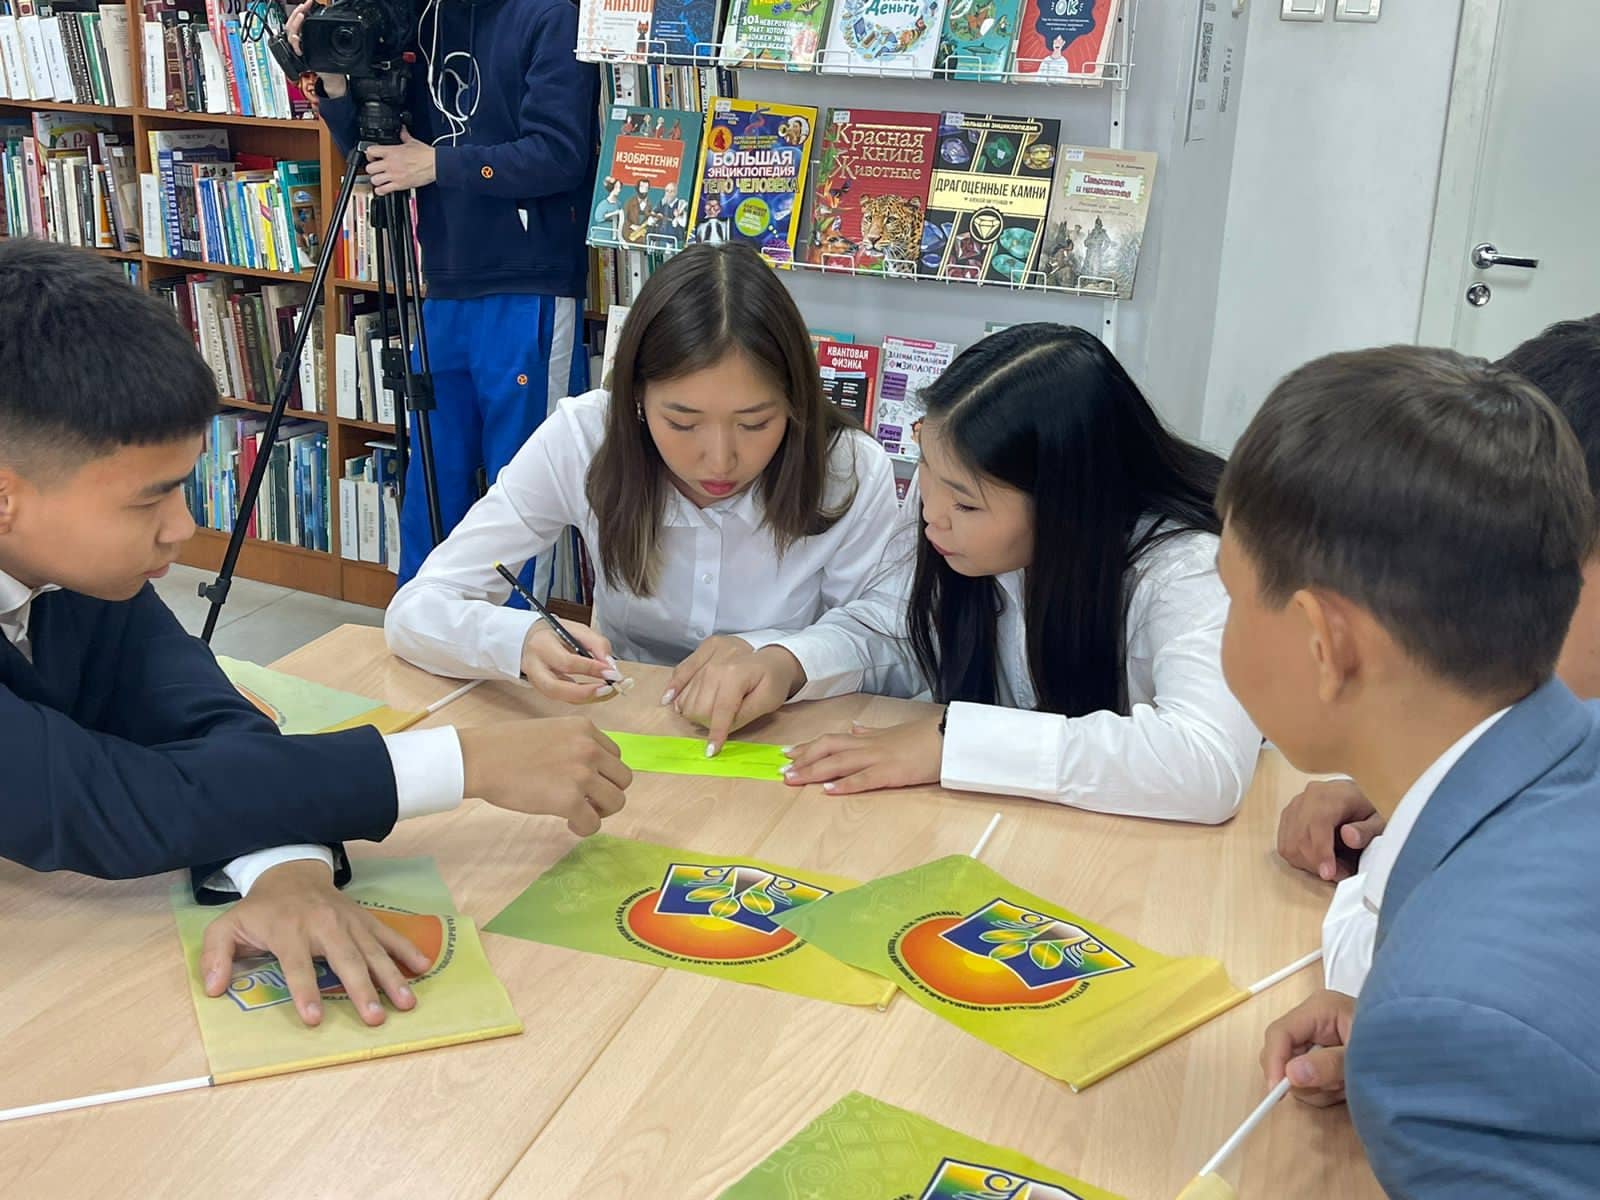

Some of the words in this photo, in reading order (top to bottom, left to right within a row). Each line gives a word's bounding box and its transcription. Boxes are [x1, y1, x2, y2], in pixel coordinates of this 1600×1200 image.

[865, 0, 919, 16] Деньги
[834, 123, 925, 151] Красная
[616, 151, 680, 169] ИЗОБРЕТЕНИЯ
[713, 150, 793, 166] БОЛЬШАЯ
[829, 150, 921, 180] Животные
[708, 166, 795, 178] ЭНЦИКЛОПЕДИЯ
[704, 178, 734, 194] ТЕЛО
[735, 177, 800, 193] ЧЕЛОВЕКА
[936, 178, 1009, 197] ДРАГОЦЕННЫЕ
[1010, 184, 1047, 200] КАМНИ
[827, 346, 869, 360] КВАНТОВАЯ
[831, 357, 863, 370] ФИЗИКА
